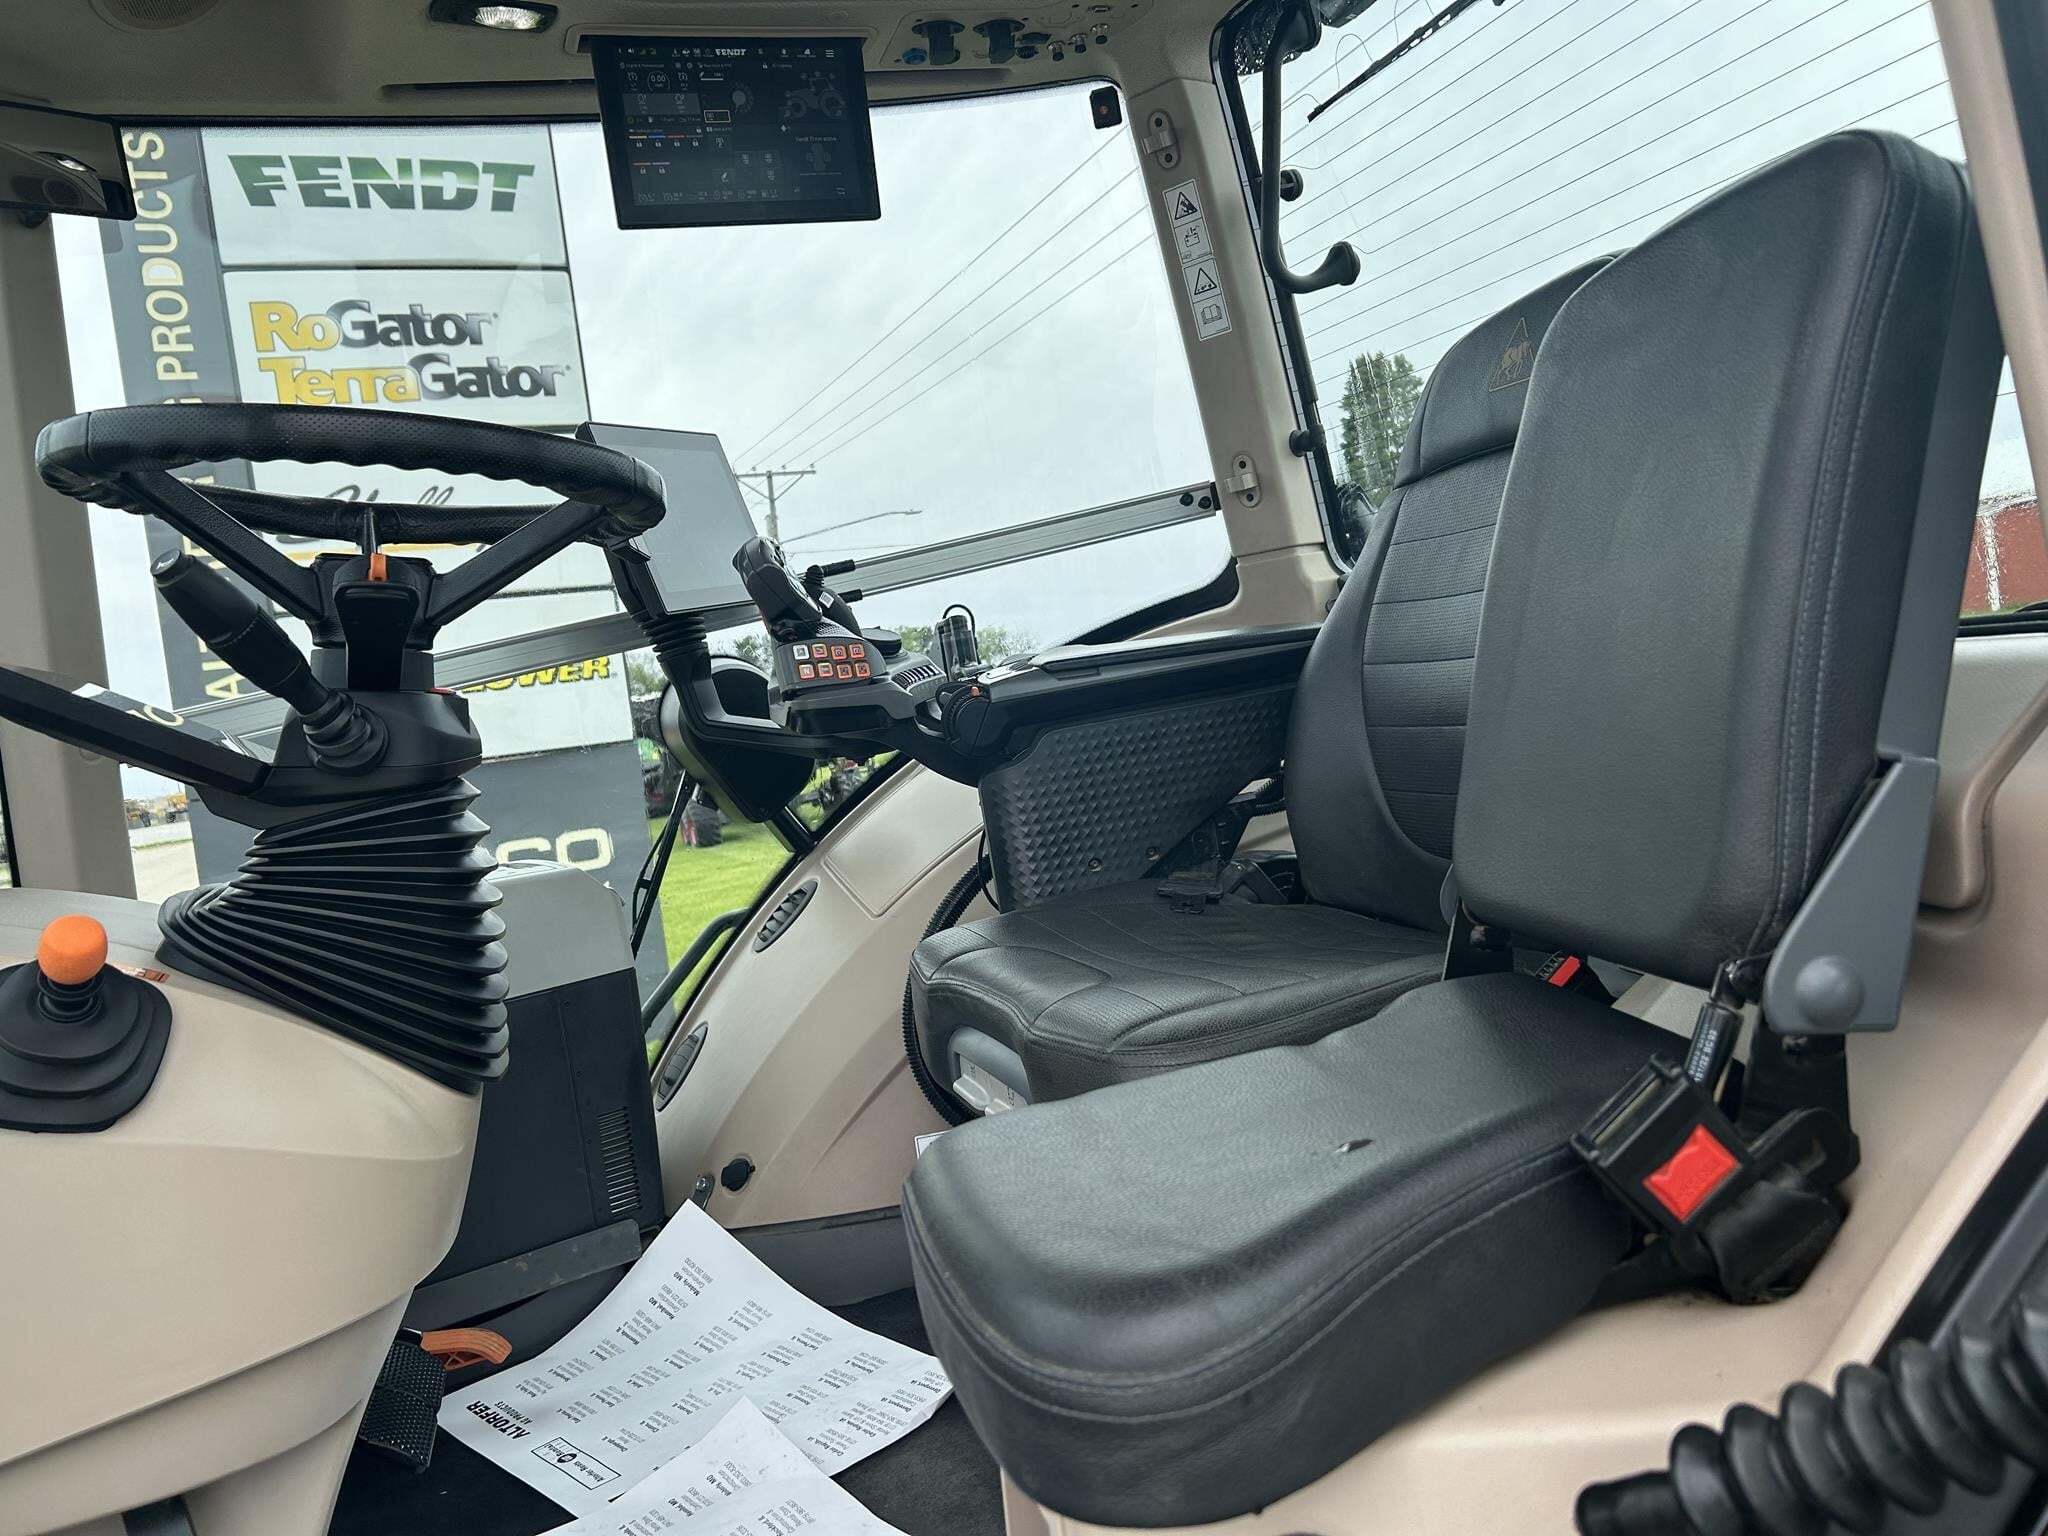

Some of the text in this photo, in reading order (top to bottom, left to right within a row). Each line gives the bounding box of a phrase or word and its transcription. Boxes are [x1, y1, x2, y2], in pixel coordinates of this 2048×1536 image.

[714, 48, 747, 56] FENDT
[228, 154, 535, 212] FENDT
[123, 131, 199, 380] PRODUCTS
[249, 300, 491, 352] RoGator
[258, 353, 564, 405] TerraGator
[466, 1400, 531, 1440] ALTORFER
